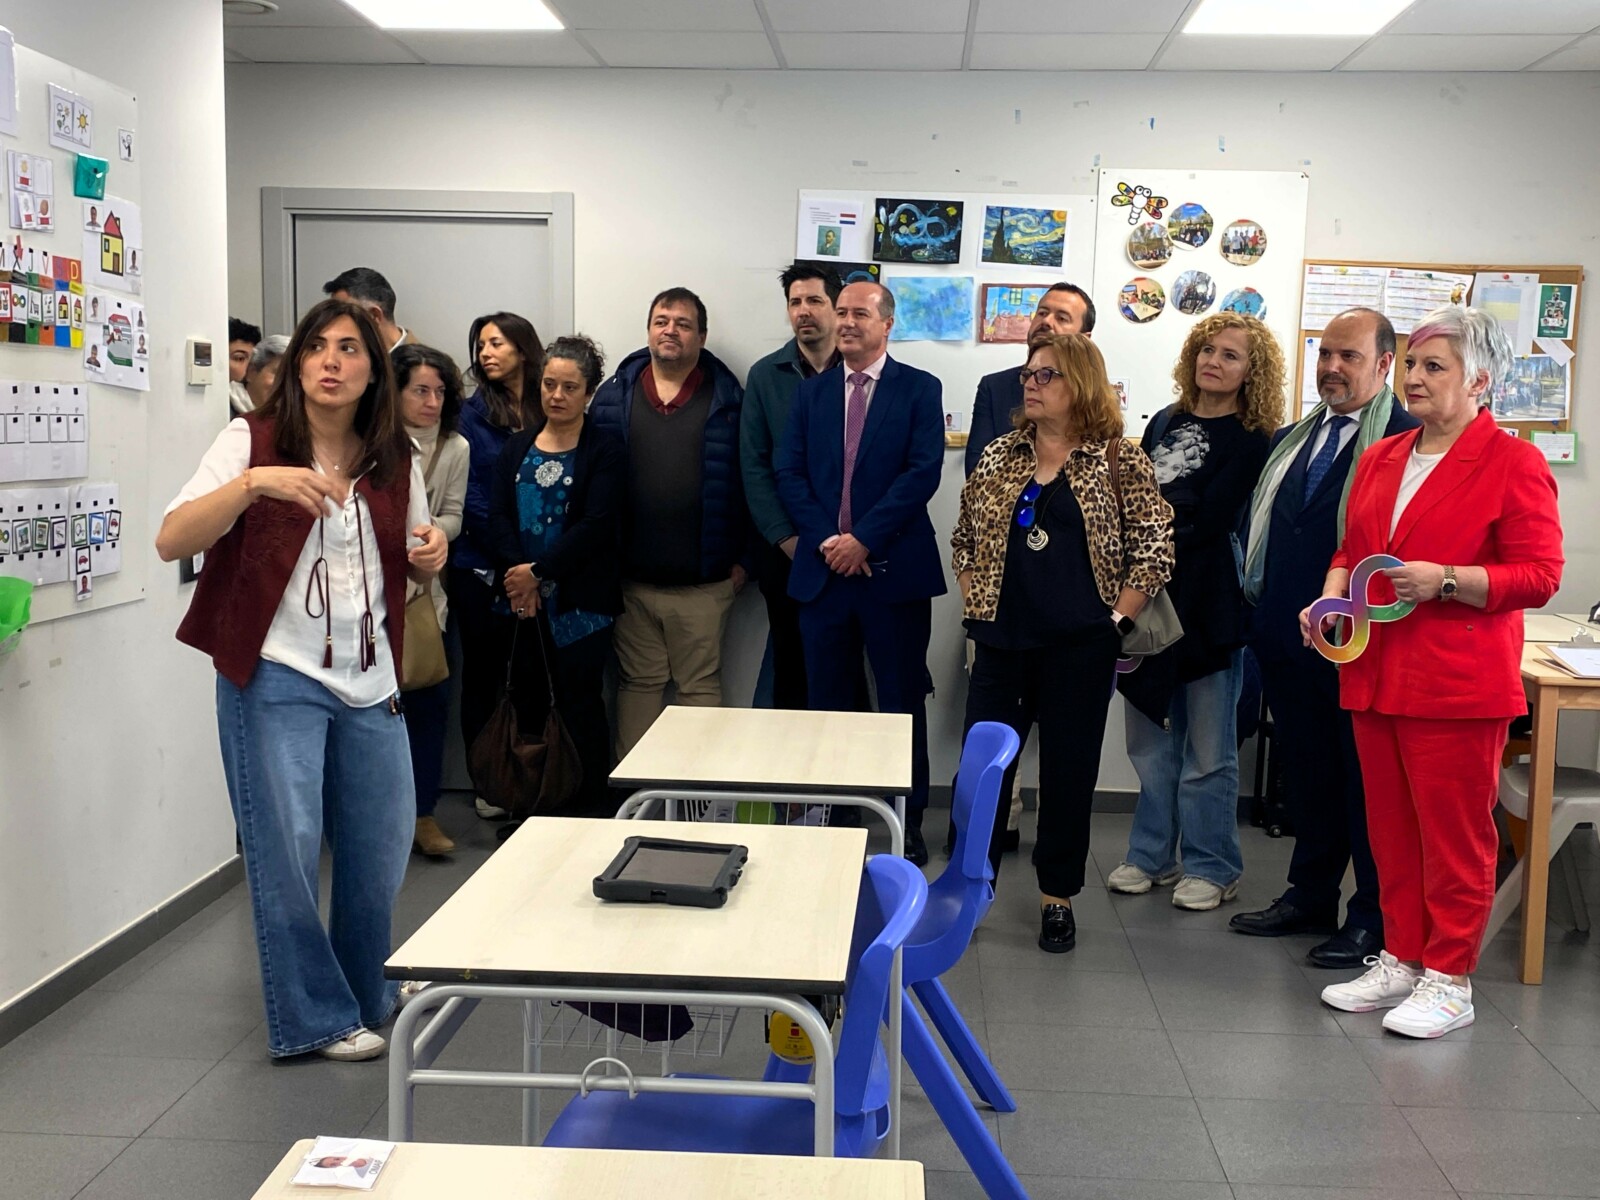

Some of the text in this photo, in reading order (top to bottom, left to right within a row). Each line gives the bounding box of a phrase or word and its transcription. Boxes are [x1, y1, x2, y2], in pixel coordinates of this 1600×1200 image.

[28, 252, 34, 272] J
[42, 254, 49, 275] V
[70, 261, 79, 280] D
